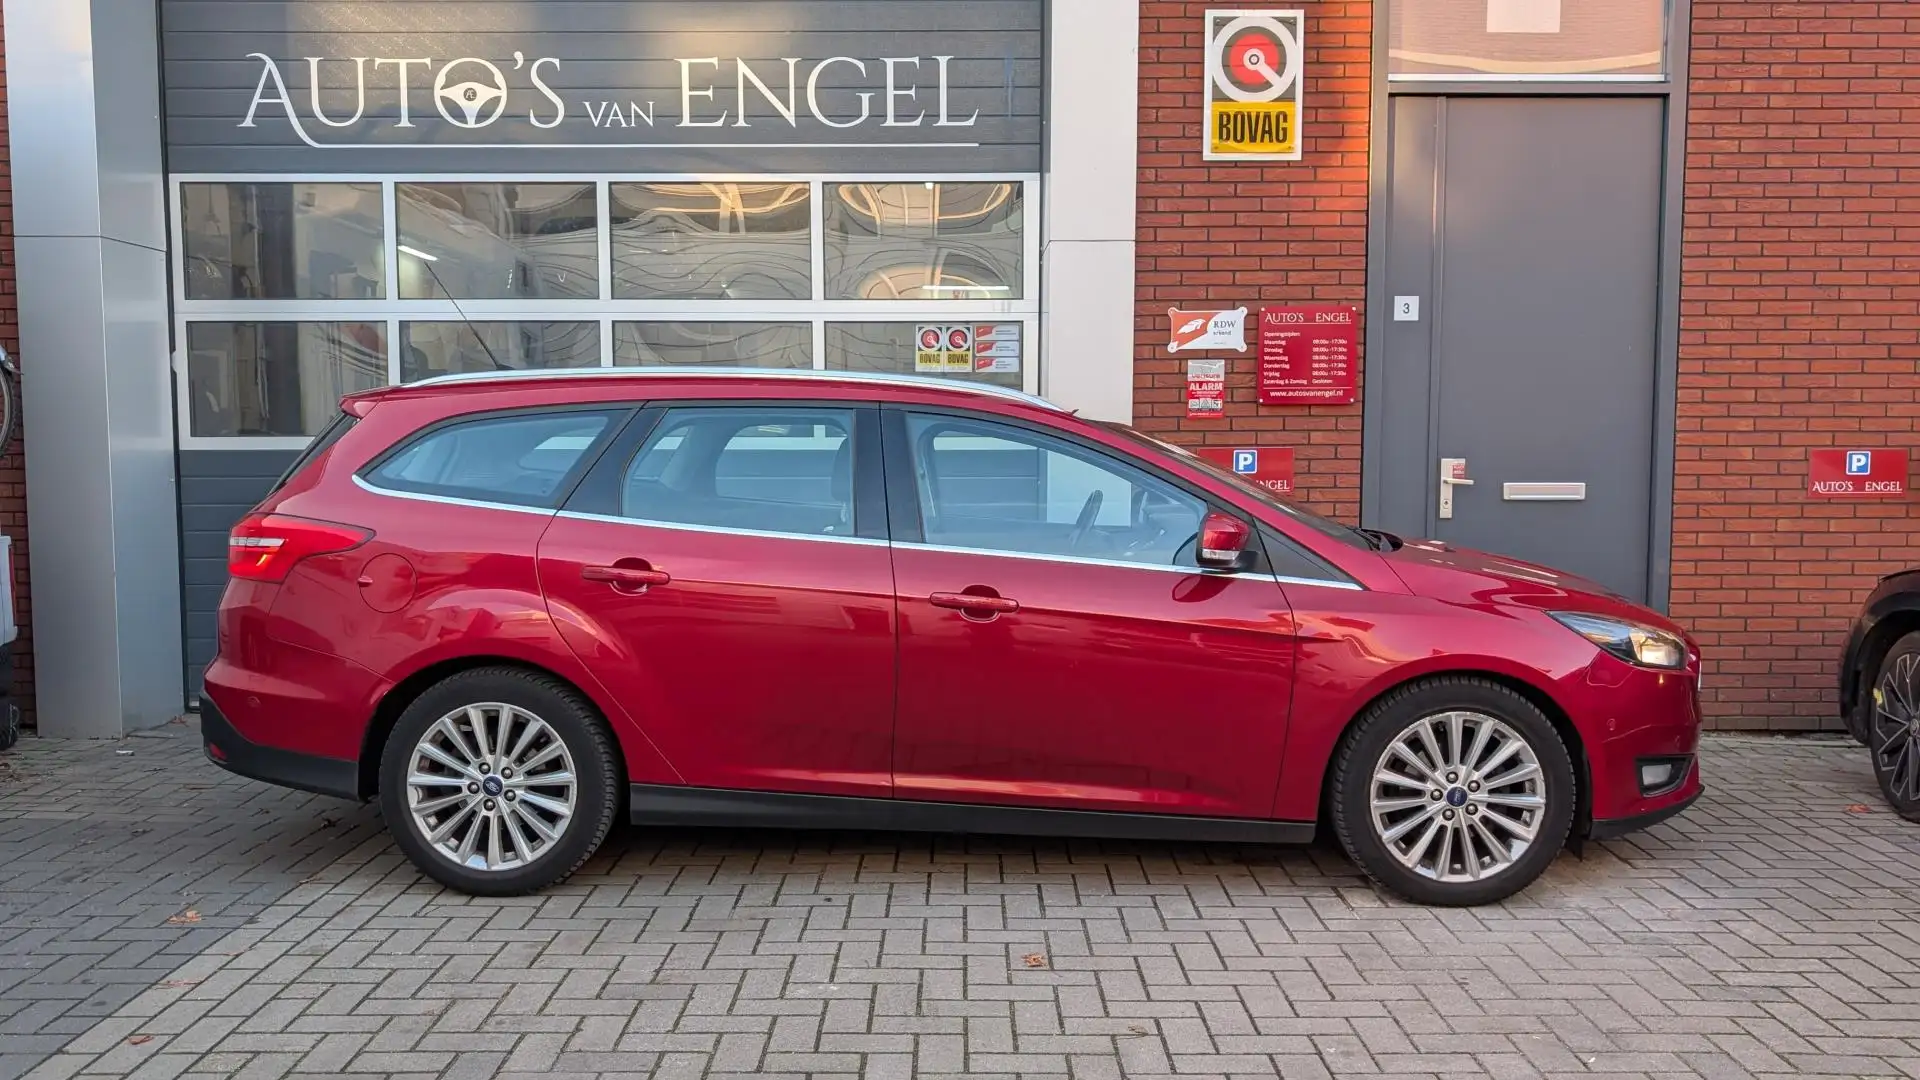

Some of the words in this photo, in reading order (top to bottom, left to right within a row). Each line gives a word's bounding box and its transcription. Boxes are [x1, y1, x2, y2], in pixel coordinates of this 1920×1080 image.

[237, 50, 566, 147] AUTO'S
[583, 101, 655, 128] VAN
[674, 55, 980, 128] ENGEL
[1218, 111, 1288, 144] BOVAG
[1402, 302, 1410, 314] 3
[1265, 312, 1304, 324] AUTO'S
[1315, 312, 1352, 322] ENGEL
[1213, 320, 1237, 329] RDW
[919, 353, 941, 364] BOVAG
[948, 353, 969, 364] BOVAG
[1190, 382, 1223, 390] ALARM
[1270, 390, 1344, 398] www.autosvanengel.nl
[1238, 453, 1253, 470] P
[1851, 454, 1866, 472] P
[1812, 481, 1853, 493] AUTO'S
[1865, 481, 1902, 492] ENGEL
